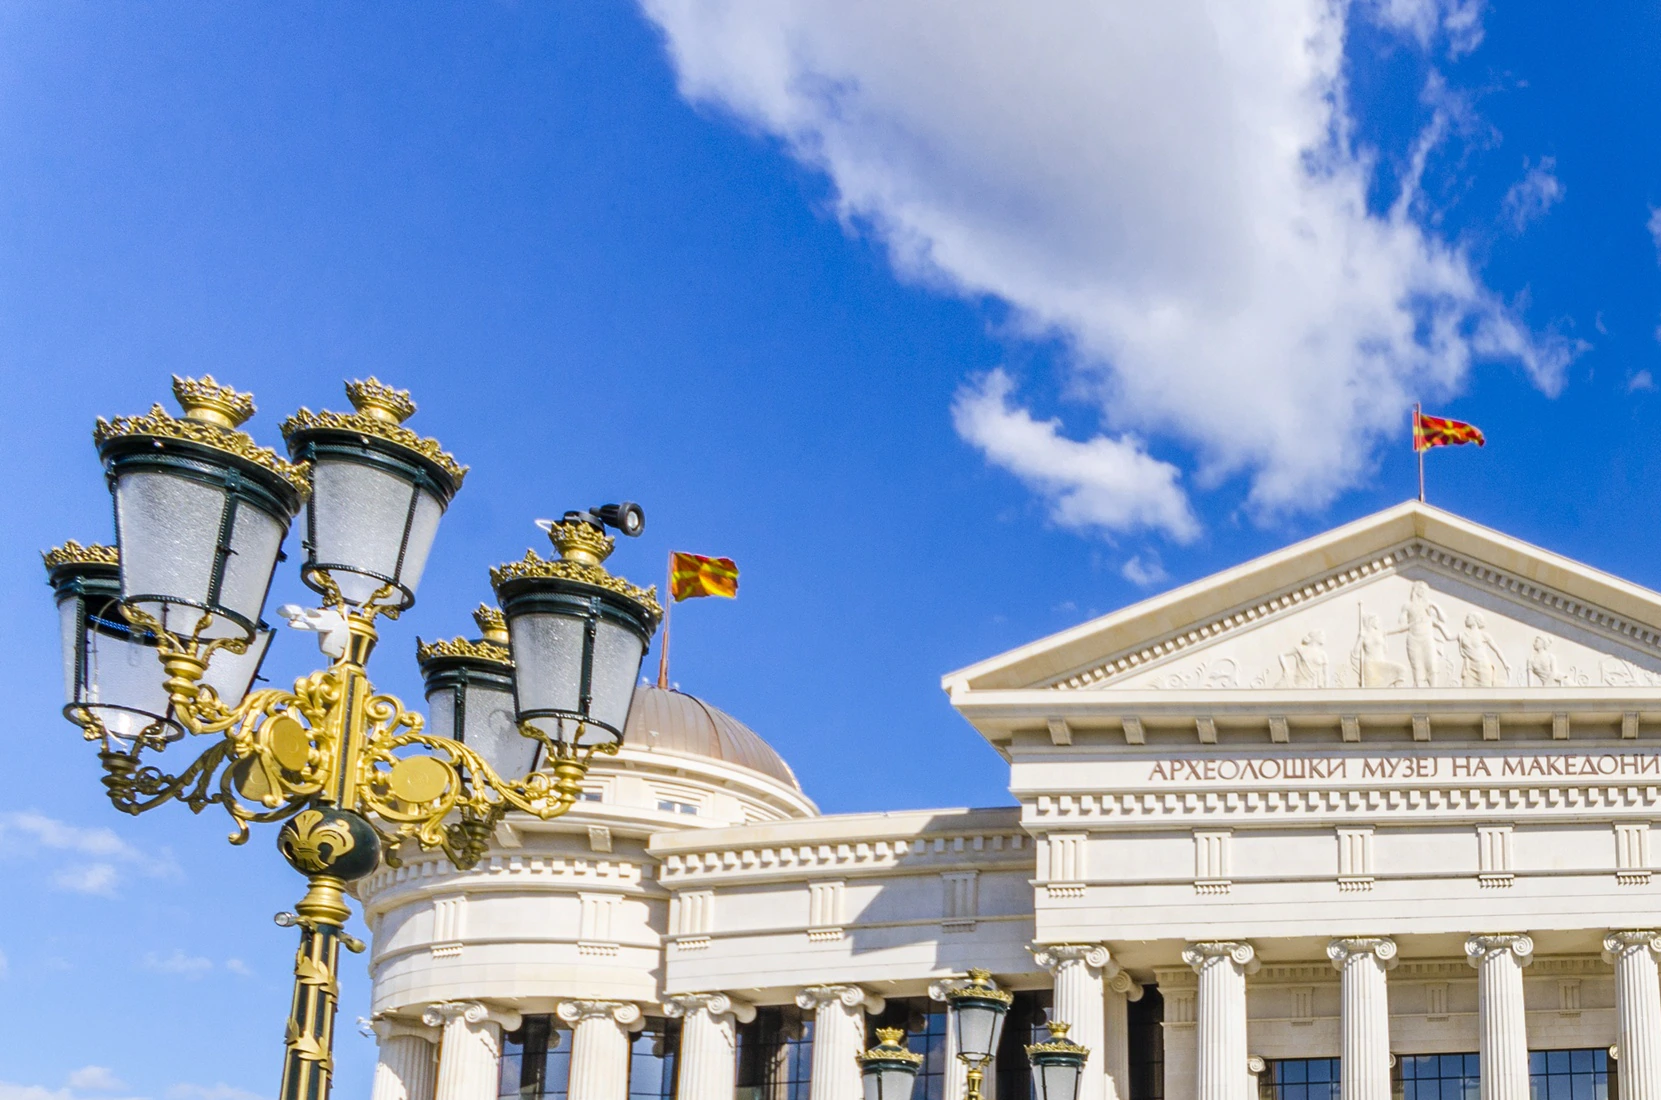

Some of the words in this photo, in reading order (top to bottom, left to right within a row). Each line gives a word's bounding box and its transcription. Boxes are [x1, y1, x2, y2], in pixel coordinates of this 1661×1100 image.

[1148, 758, 1347, 781] АРХЕОЛОШКИ
[1362, 757, 1438, 778] МУЗЕЈ
[1452, 756, 1491, 777] НА
